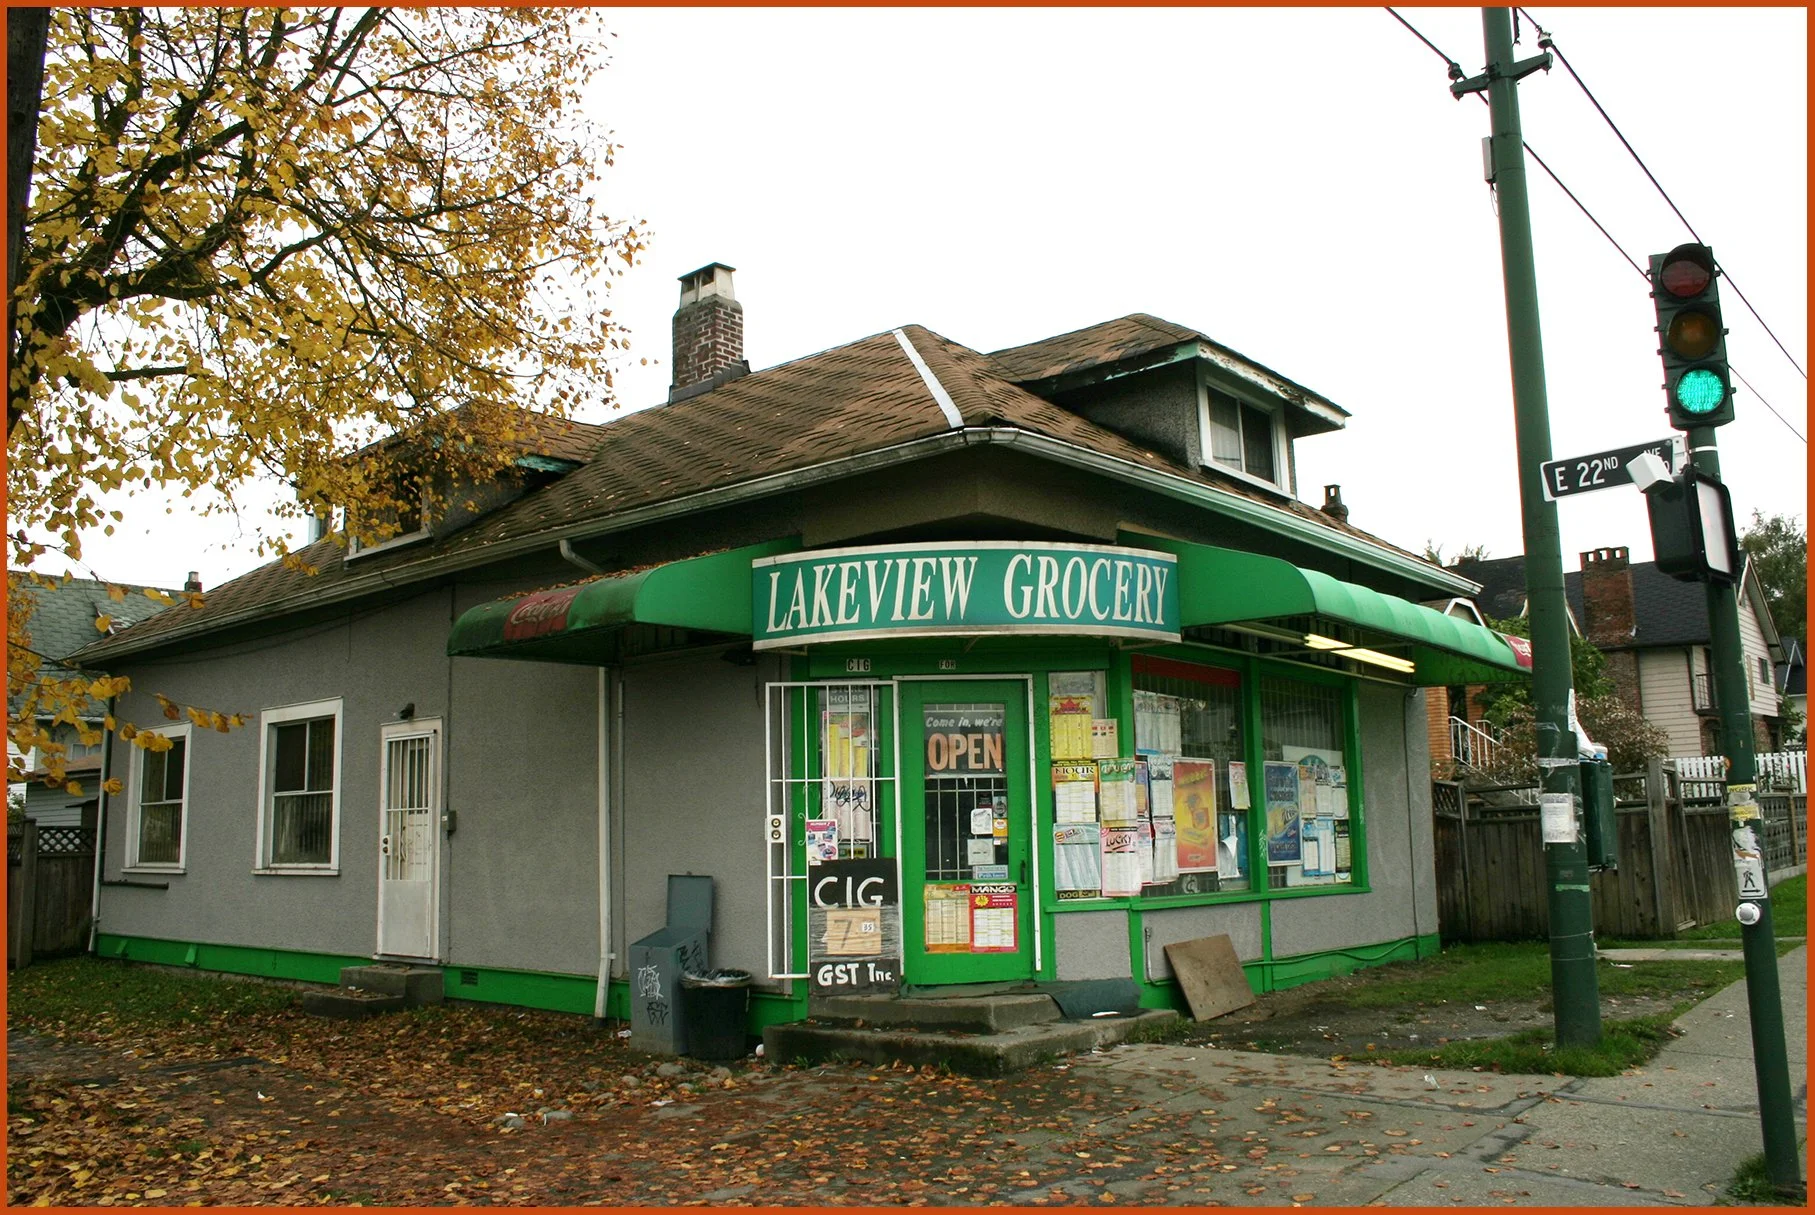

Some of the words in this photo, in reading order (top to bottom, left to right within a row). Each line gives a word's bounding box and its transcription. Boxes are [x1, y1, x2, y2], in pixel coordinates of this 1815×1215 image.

[1554, 466, 1569, 492] E
[1576, 456, 1619, 488] 22ND
[766, 556, 979, 634] LAKEVIEW
[1003, 553, 1169, 626] GROCERY
[847, 658, 870, 671] CIG
[925, 716, 956, 728] Come
[974, 716, 1003, 727] we're
[927, 732, 1003, 771] OPEN
[1106, 834, 1132, 848] LUCKY
[814, 876, 884, 910] CIG
[971, 885, 1016, 894] MANGO
[833, 918, 853, 950] 7
[817, 963, 859, 987] GST
[867, 963, 895, 983] Inc.
